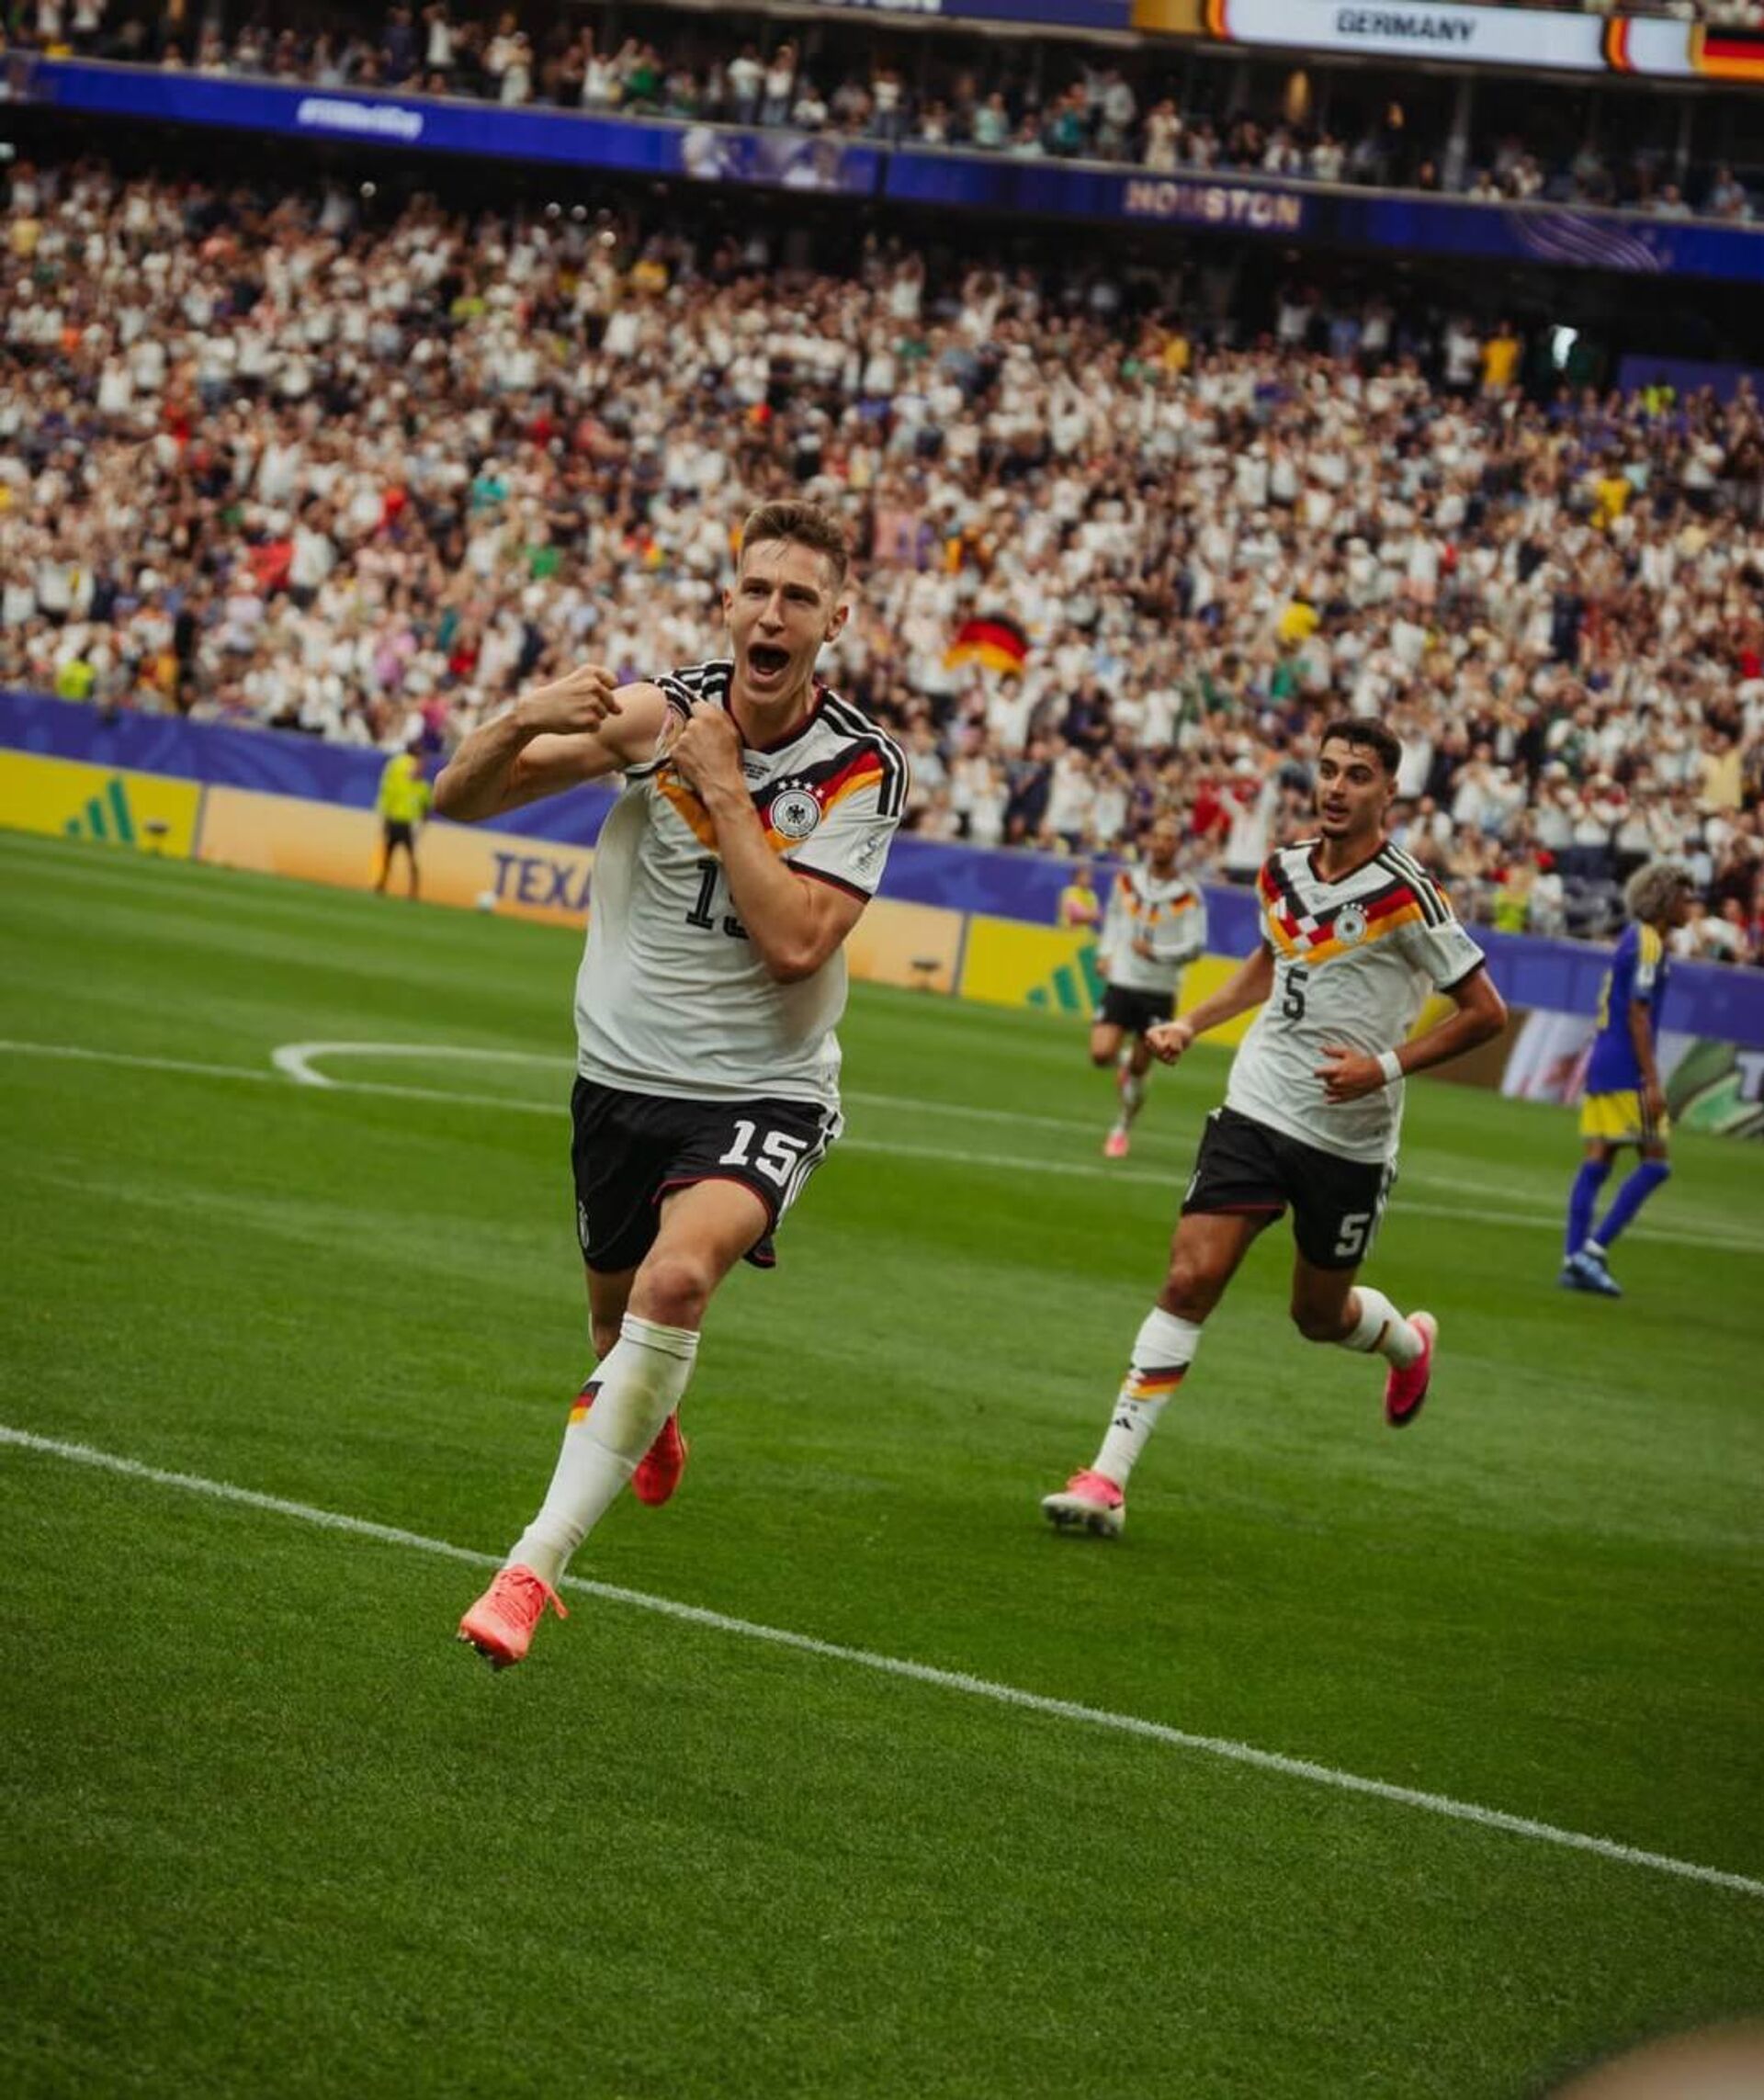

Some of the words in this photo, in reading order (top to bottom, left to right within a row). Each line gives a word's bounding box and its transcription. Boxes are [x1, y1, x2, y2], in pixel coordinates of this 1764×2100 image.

[1338, 9, 1476, 40] GERMANY
[686, 857, 750, 939] 1
[1283, 967, 1308, 1021] 5
[719, 1120, 808, 1186] 15
[1335, 1214, 1369, 1257] 5
